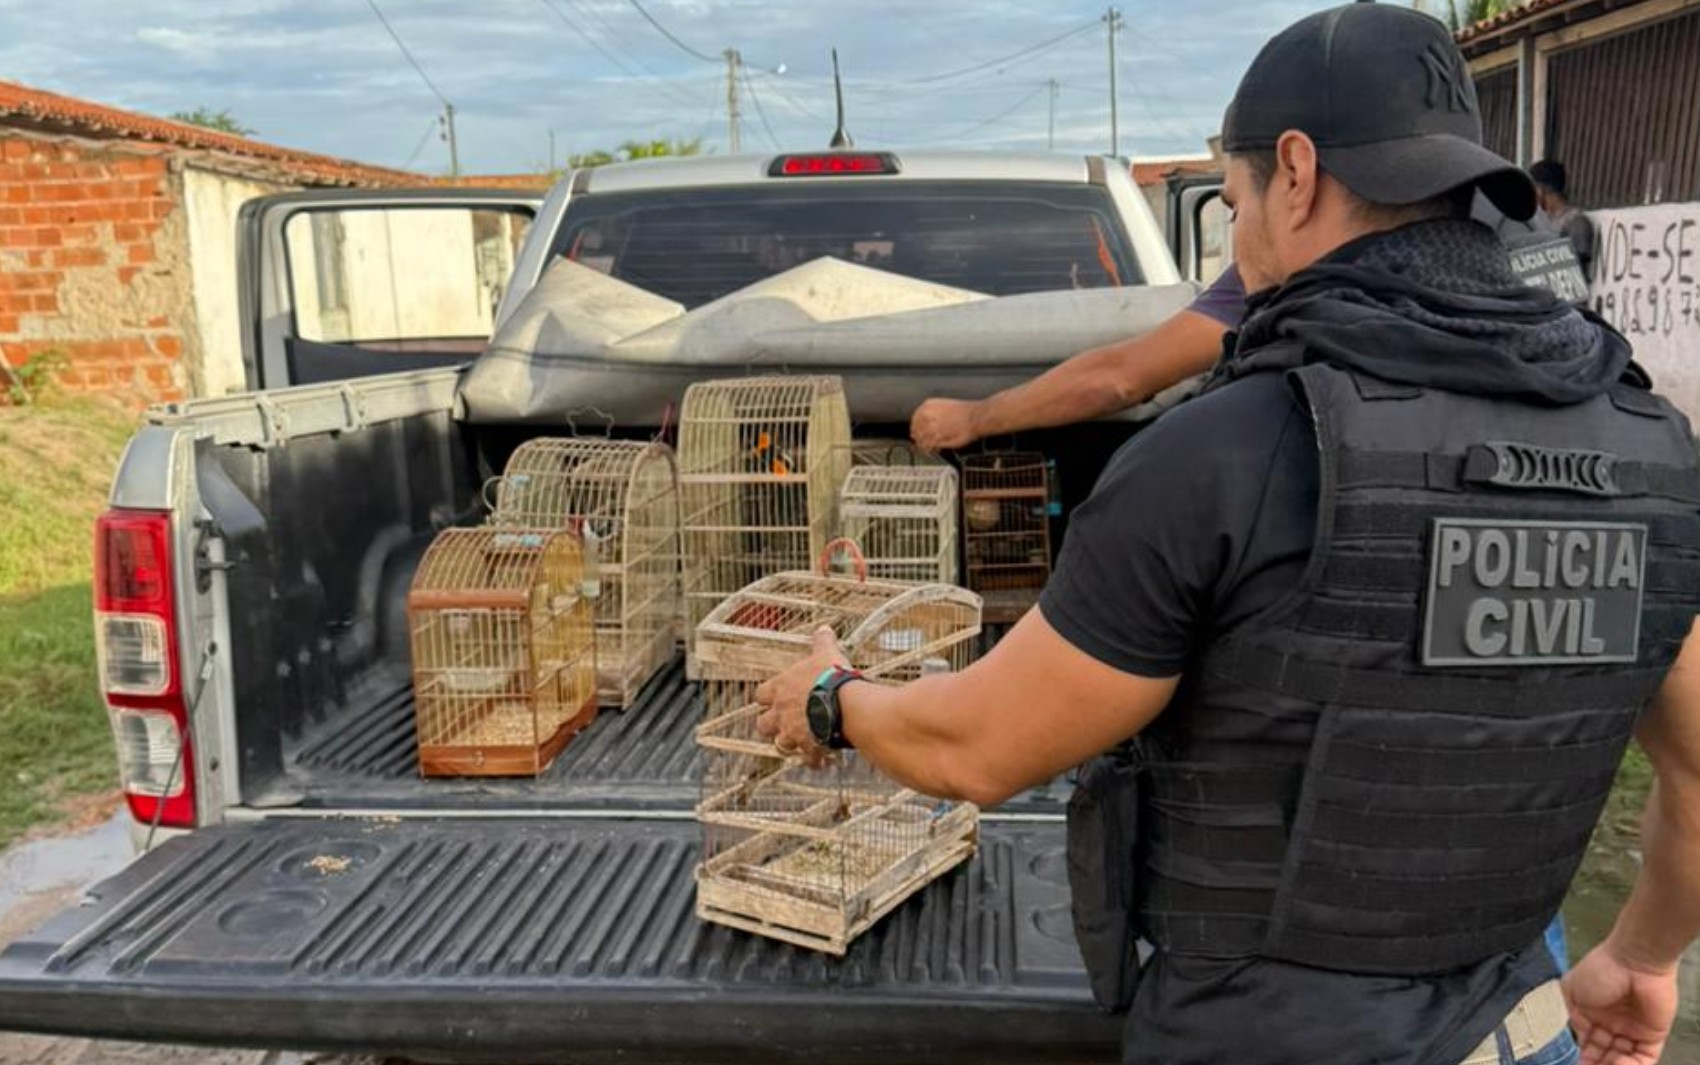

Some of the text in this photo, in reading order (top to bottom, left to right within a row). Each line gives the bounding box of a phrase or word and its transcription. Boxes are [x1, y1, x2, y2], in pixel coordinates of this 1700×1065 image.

[1417, 43, 1475, 114] NY
[1594, 217, 1696, 286] NDE-SE
[1465, 597, 1606, 657] CIVIL
